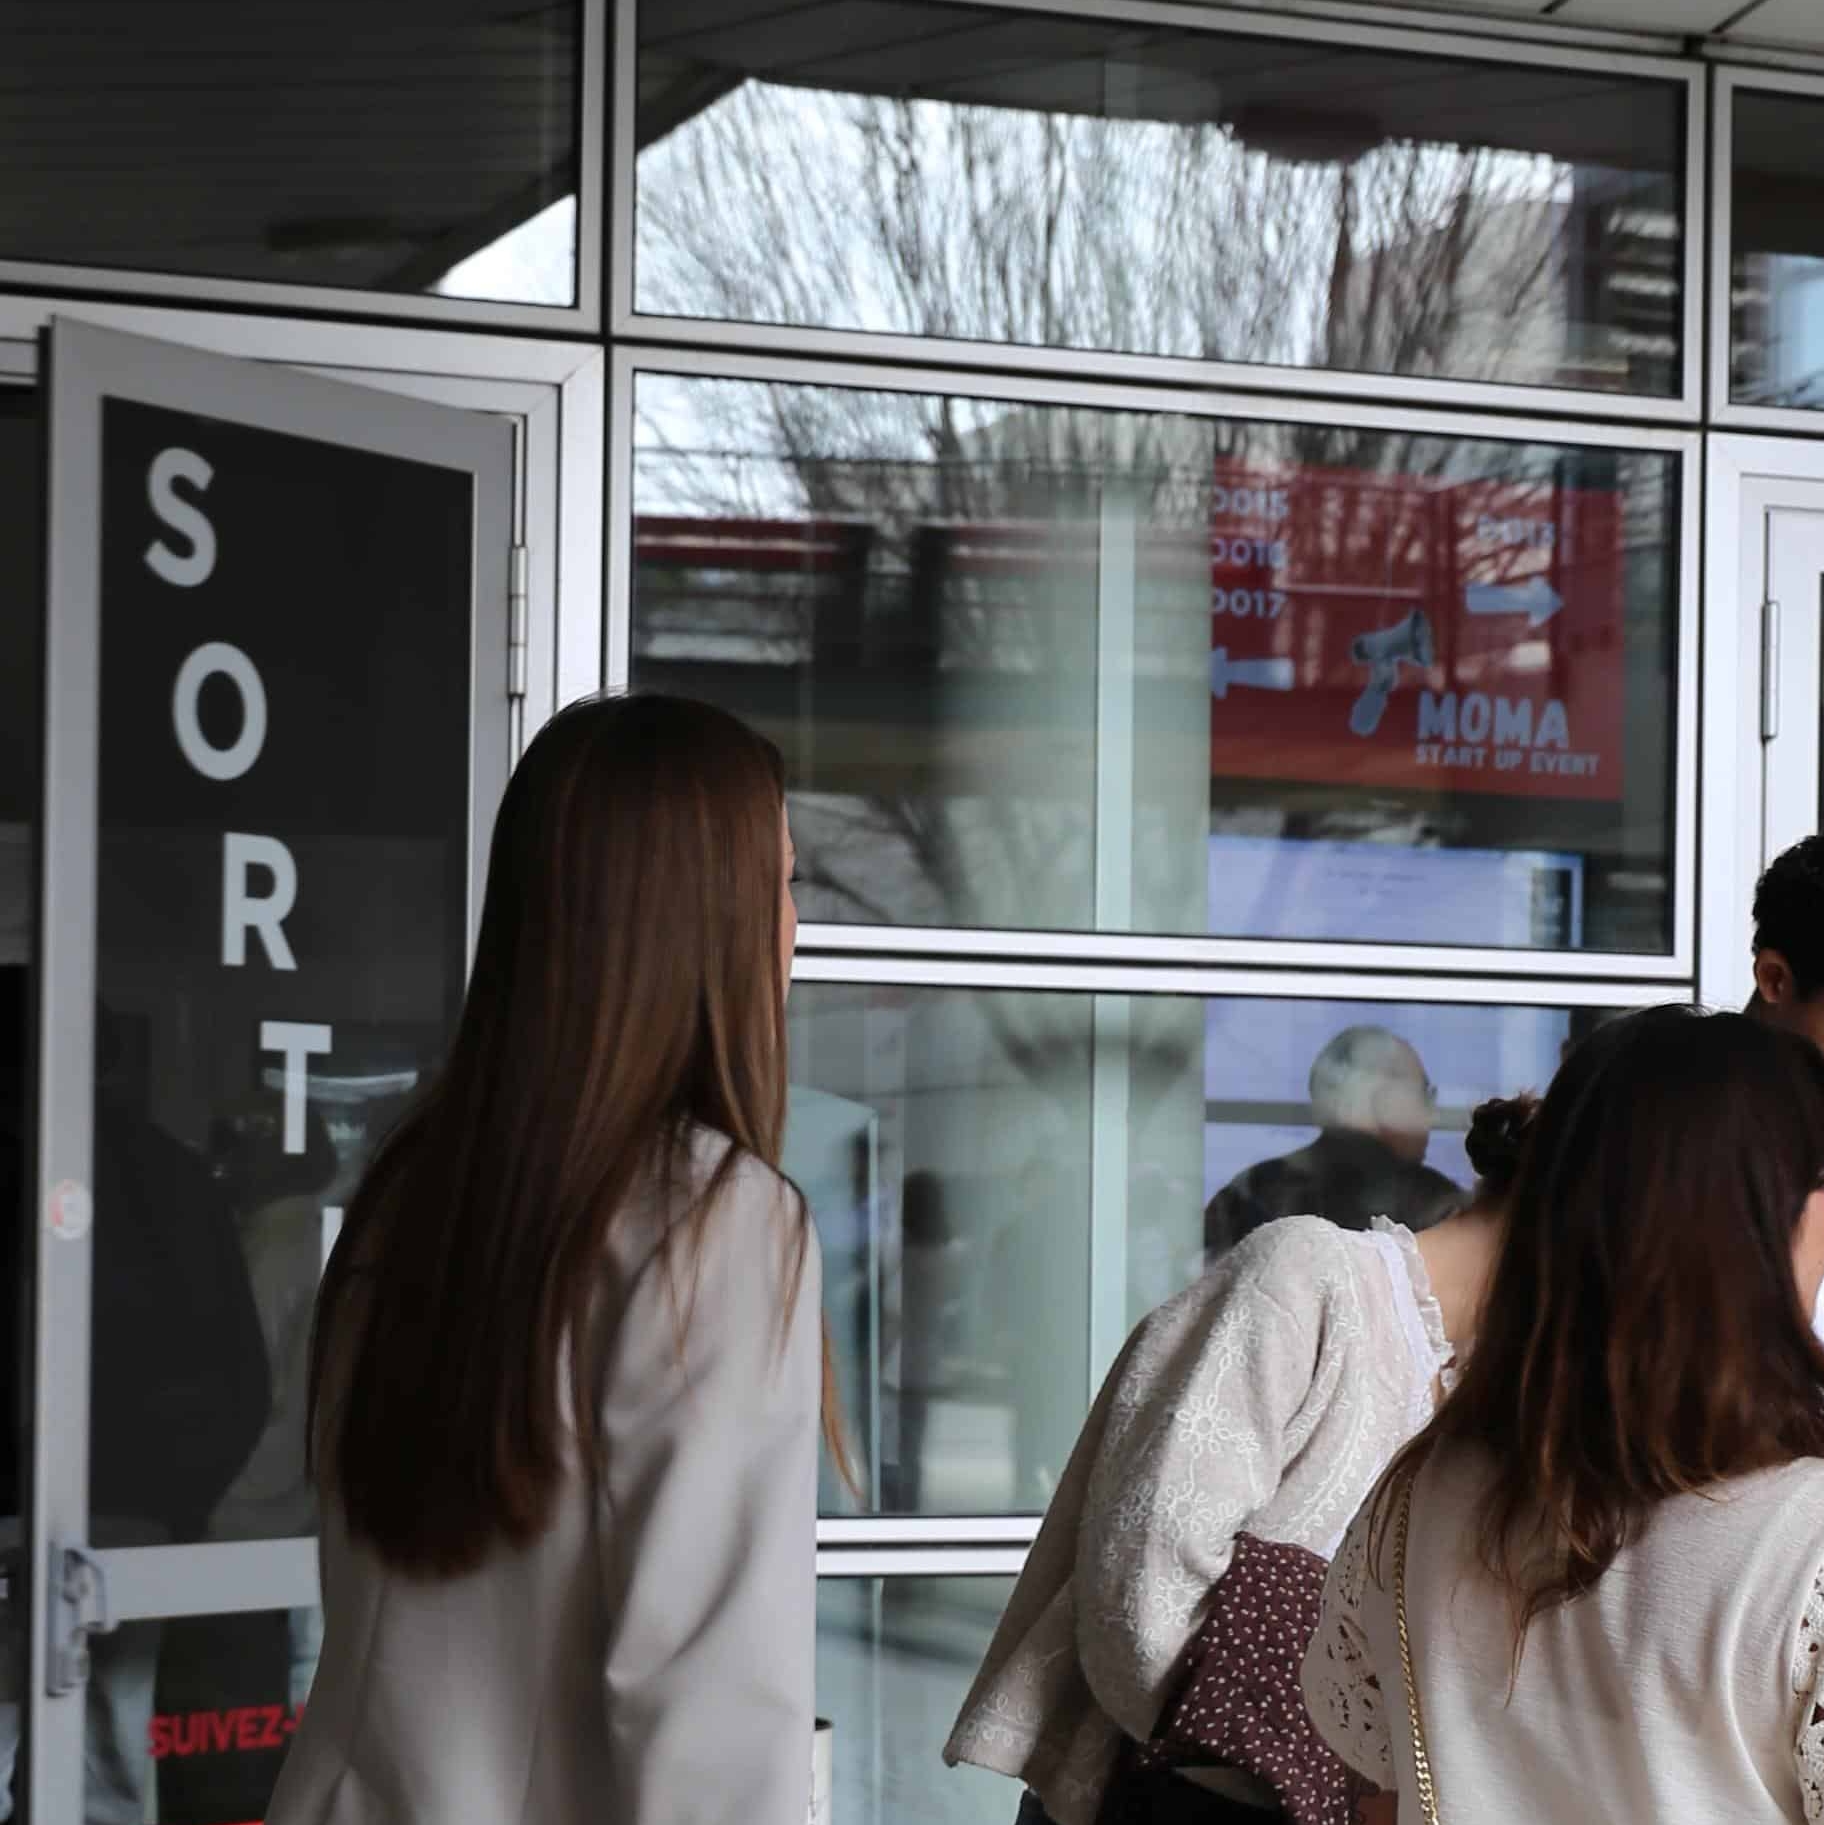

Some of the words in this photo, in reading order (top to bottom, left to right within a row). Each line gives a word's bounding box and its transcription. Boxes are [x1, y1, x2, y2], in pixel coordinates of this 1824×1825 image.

[1417, 690, 1570, 749] MOMA
[1415, 744, 1486, 768] START
[1495, 750, 1523, 770] UP
[1530, 752, 1600, 777] EVENT
[147, 1702, 305, 1759] SUIVEZ-
